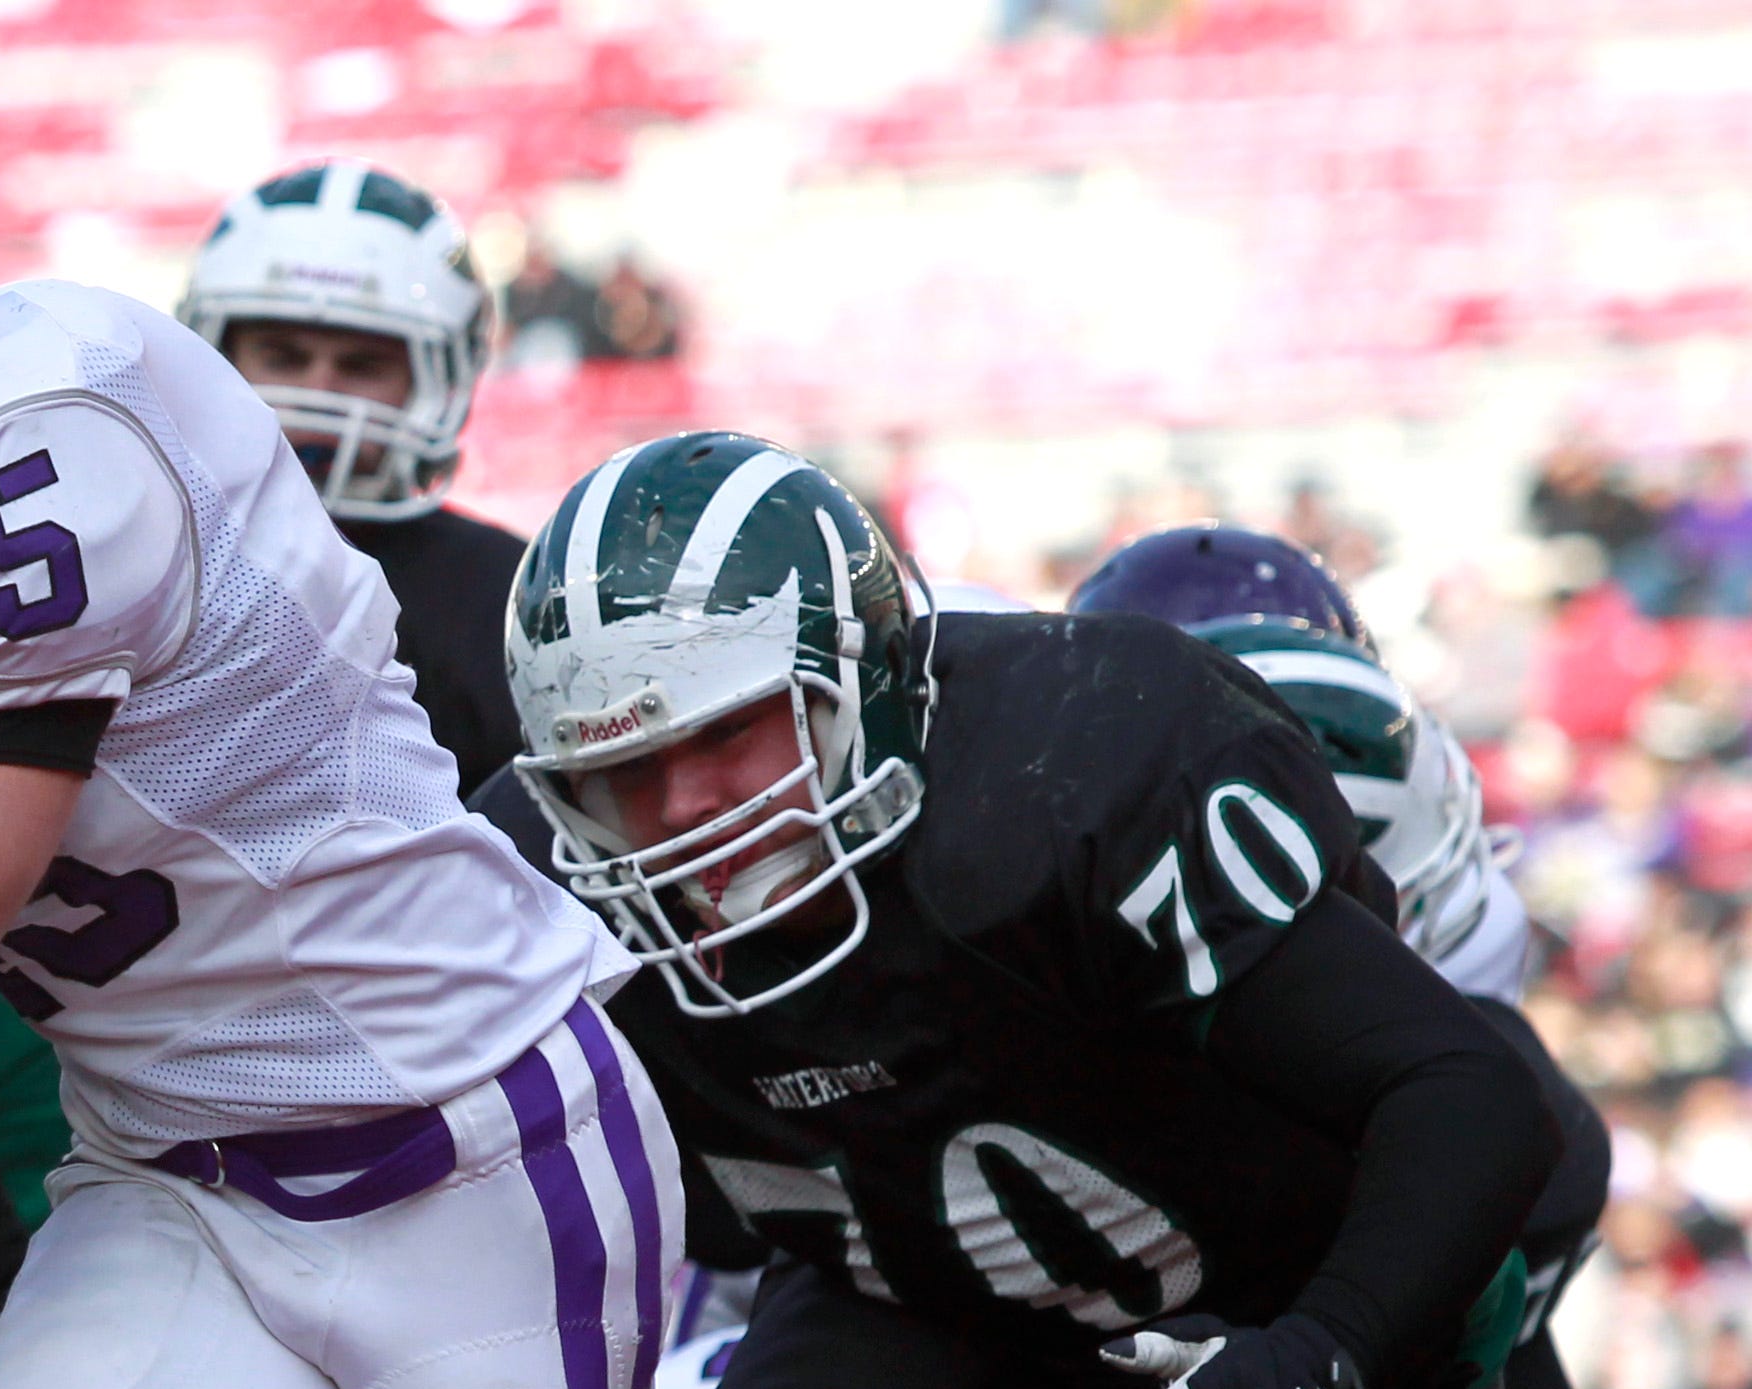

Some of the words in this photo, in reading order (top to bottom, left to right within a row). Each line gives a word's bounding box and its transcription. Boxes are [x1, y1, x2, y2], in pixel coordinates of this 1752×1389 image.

[578, 701, 641, 743] Riddel
[1116, 780, 1324, 998] 70
[700, 1122, 1204, 1332] 70
